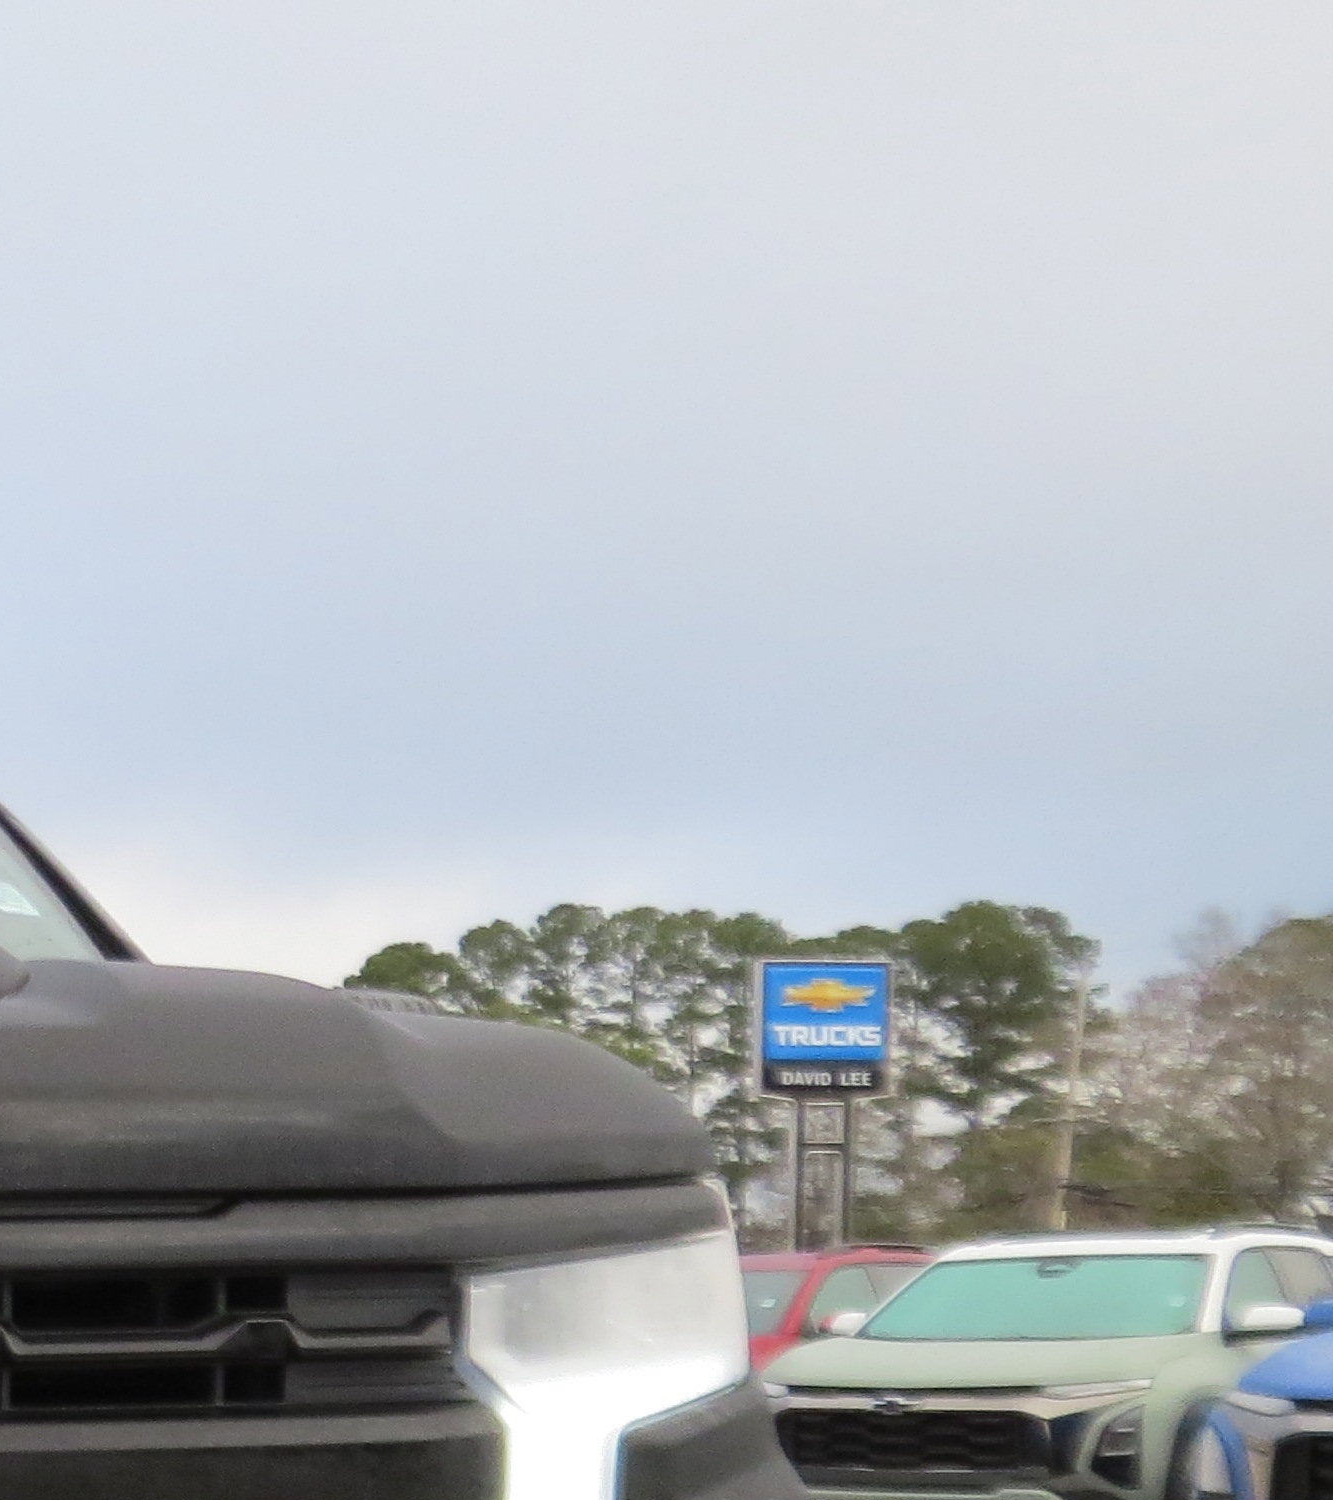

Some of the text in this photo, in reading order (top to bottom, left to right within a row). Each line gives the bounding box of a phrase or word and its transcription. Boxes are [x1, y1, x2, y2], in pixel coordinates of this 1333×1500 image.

[774, 1026, 882, 1046] TRUCKS
[783, 1071, 872, 1086] DAVID LEE
